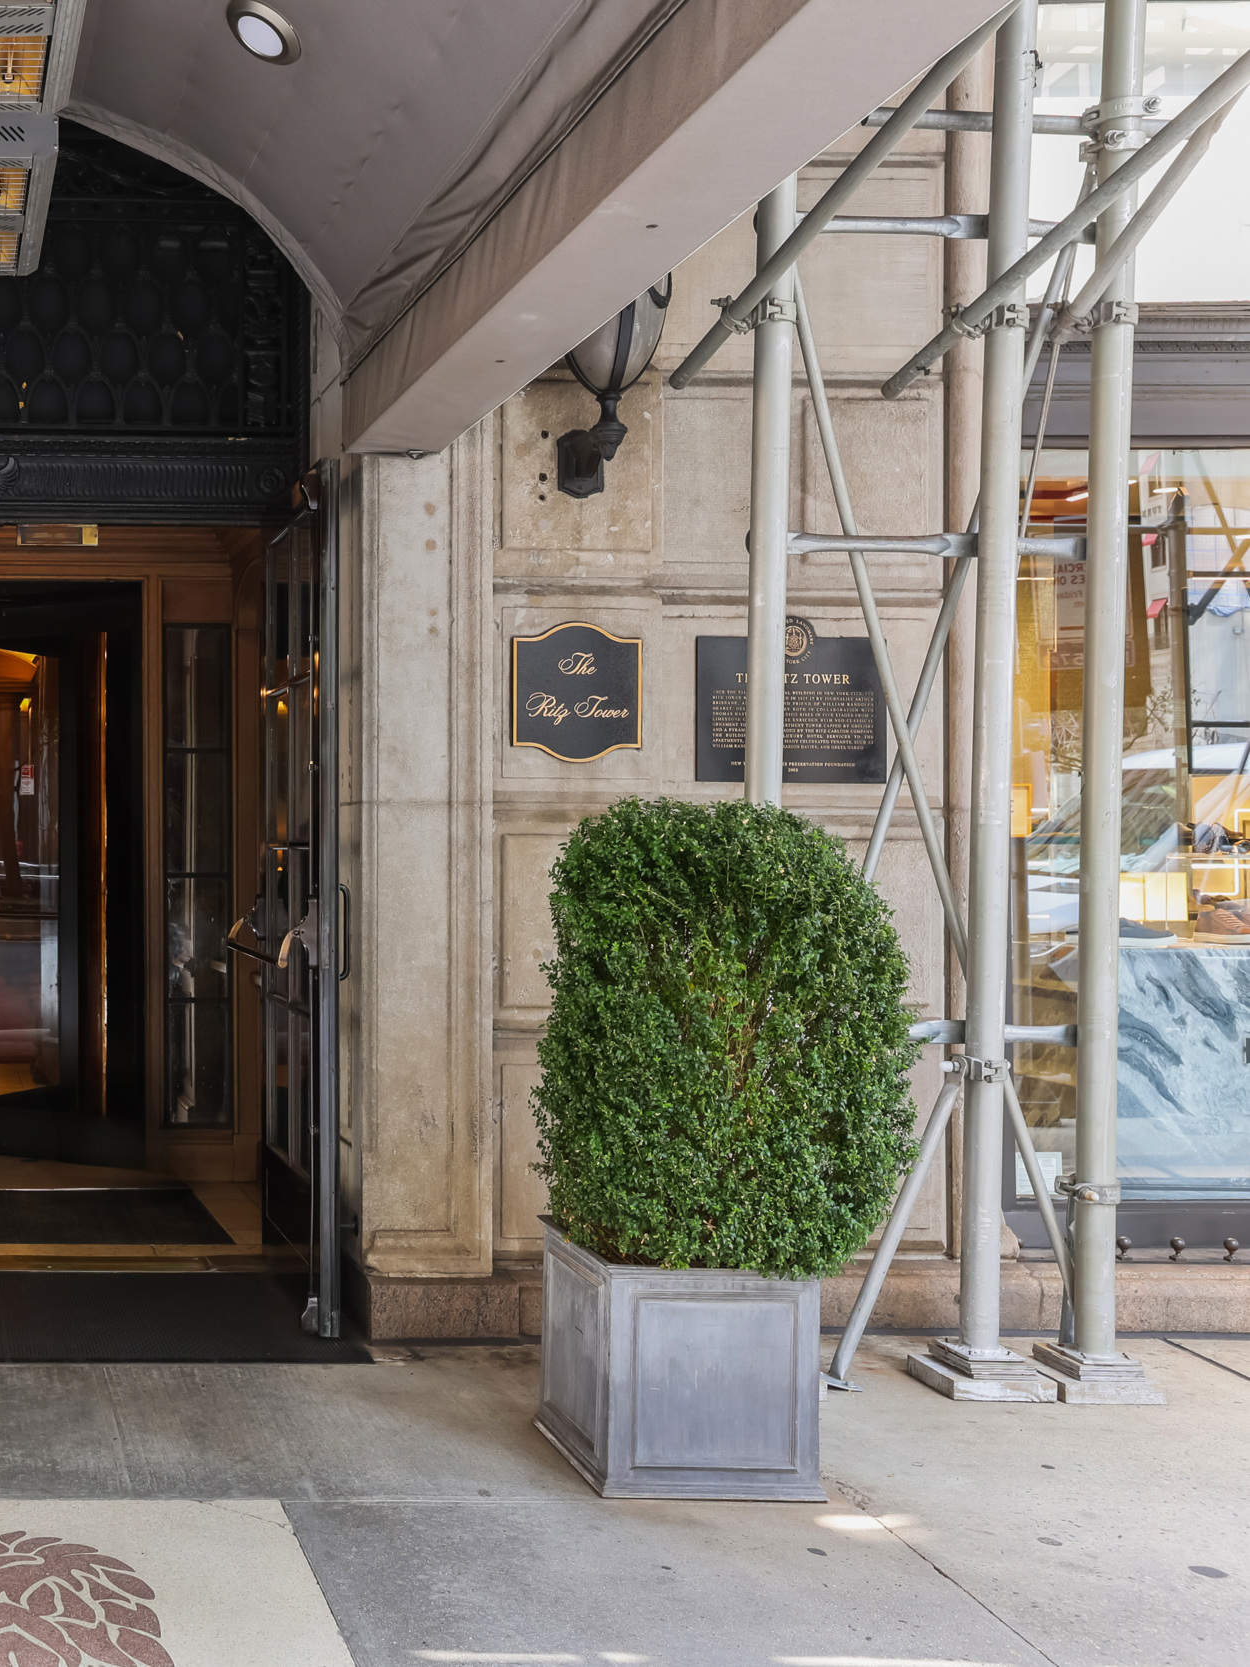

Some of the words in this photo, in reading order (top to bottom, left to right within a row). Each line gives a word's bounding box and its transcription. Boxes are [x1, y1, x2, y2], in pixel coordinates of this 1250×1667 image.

[558, 652, 598, 675] The
[784, 673, 799, 684] TZ
[803, 673, 851, 685] TOWER
[525, 691, 571, 726] Ritz
[573, 695, 630, 718] Tower
